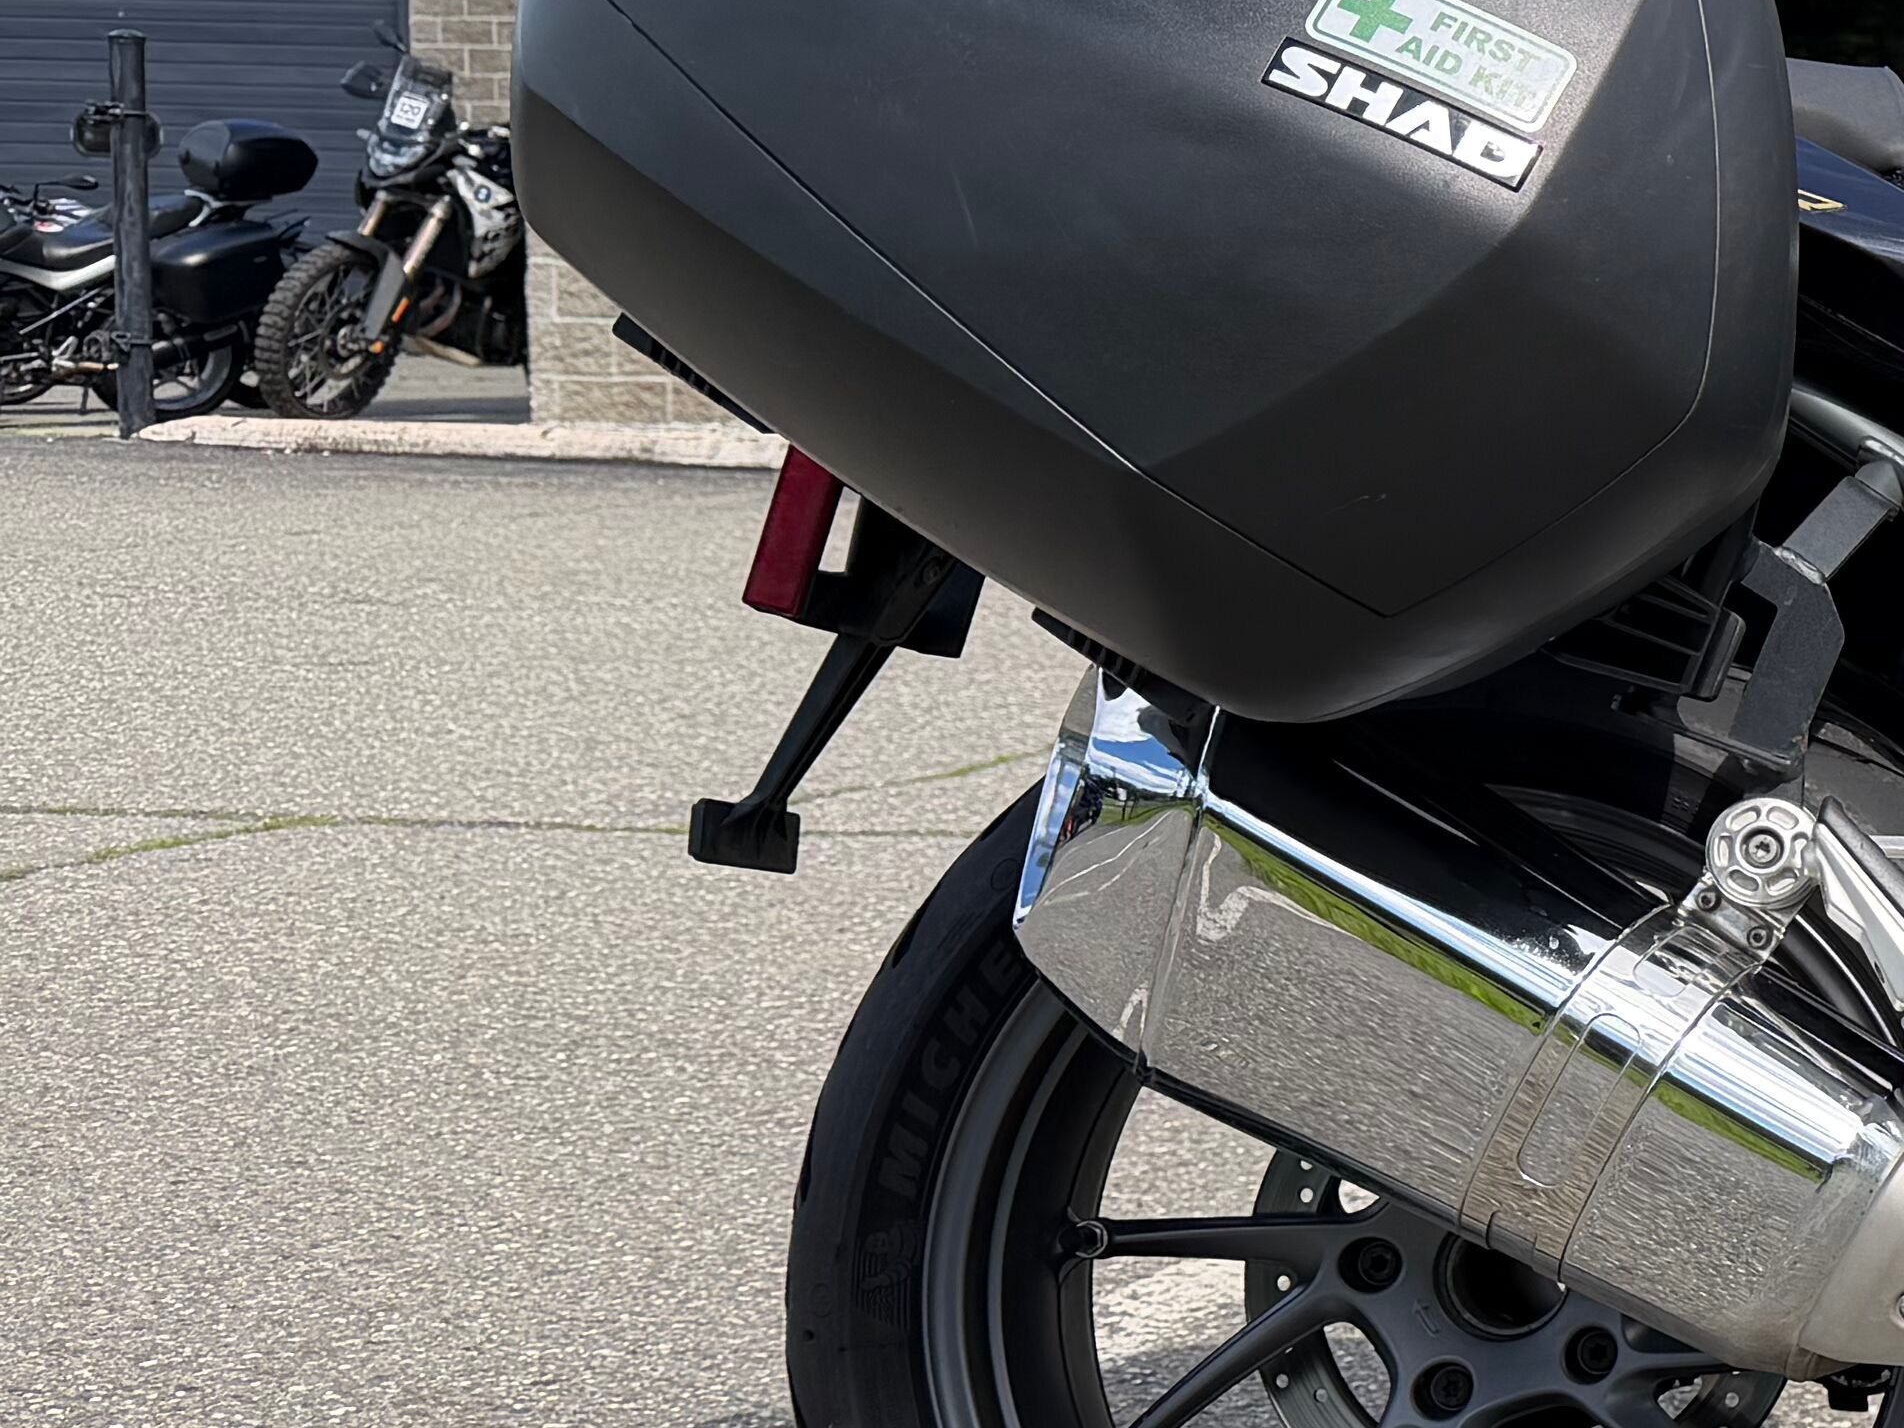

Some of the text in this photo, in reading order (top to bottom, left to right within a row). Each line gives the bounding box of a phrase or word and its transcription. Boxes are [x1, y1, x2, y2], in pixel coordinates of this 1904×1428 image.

[1396, 35, 1540, 112] AID KIT
[1429, 11, 1541, 71] FIRST
[1268, 45, 1541, 181] SHAD
